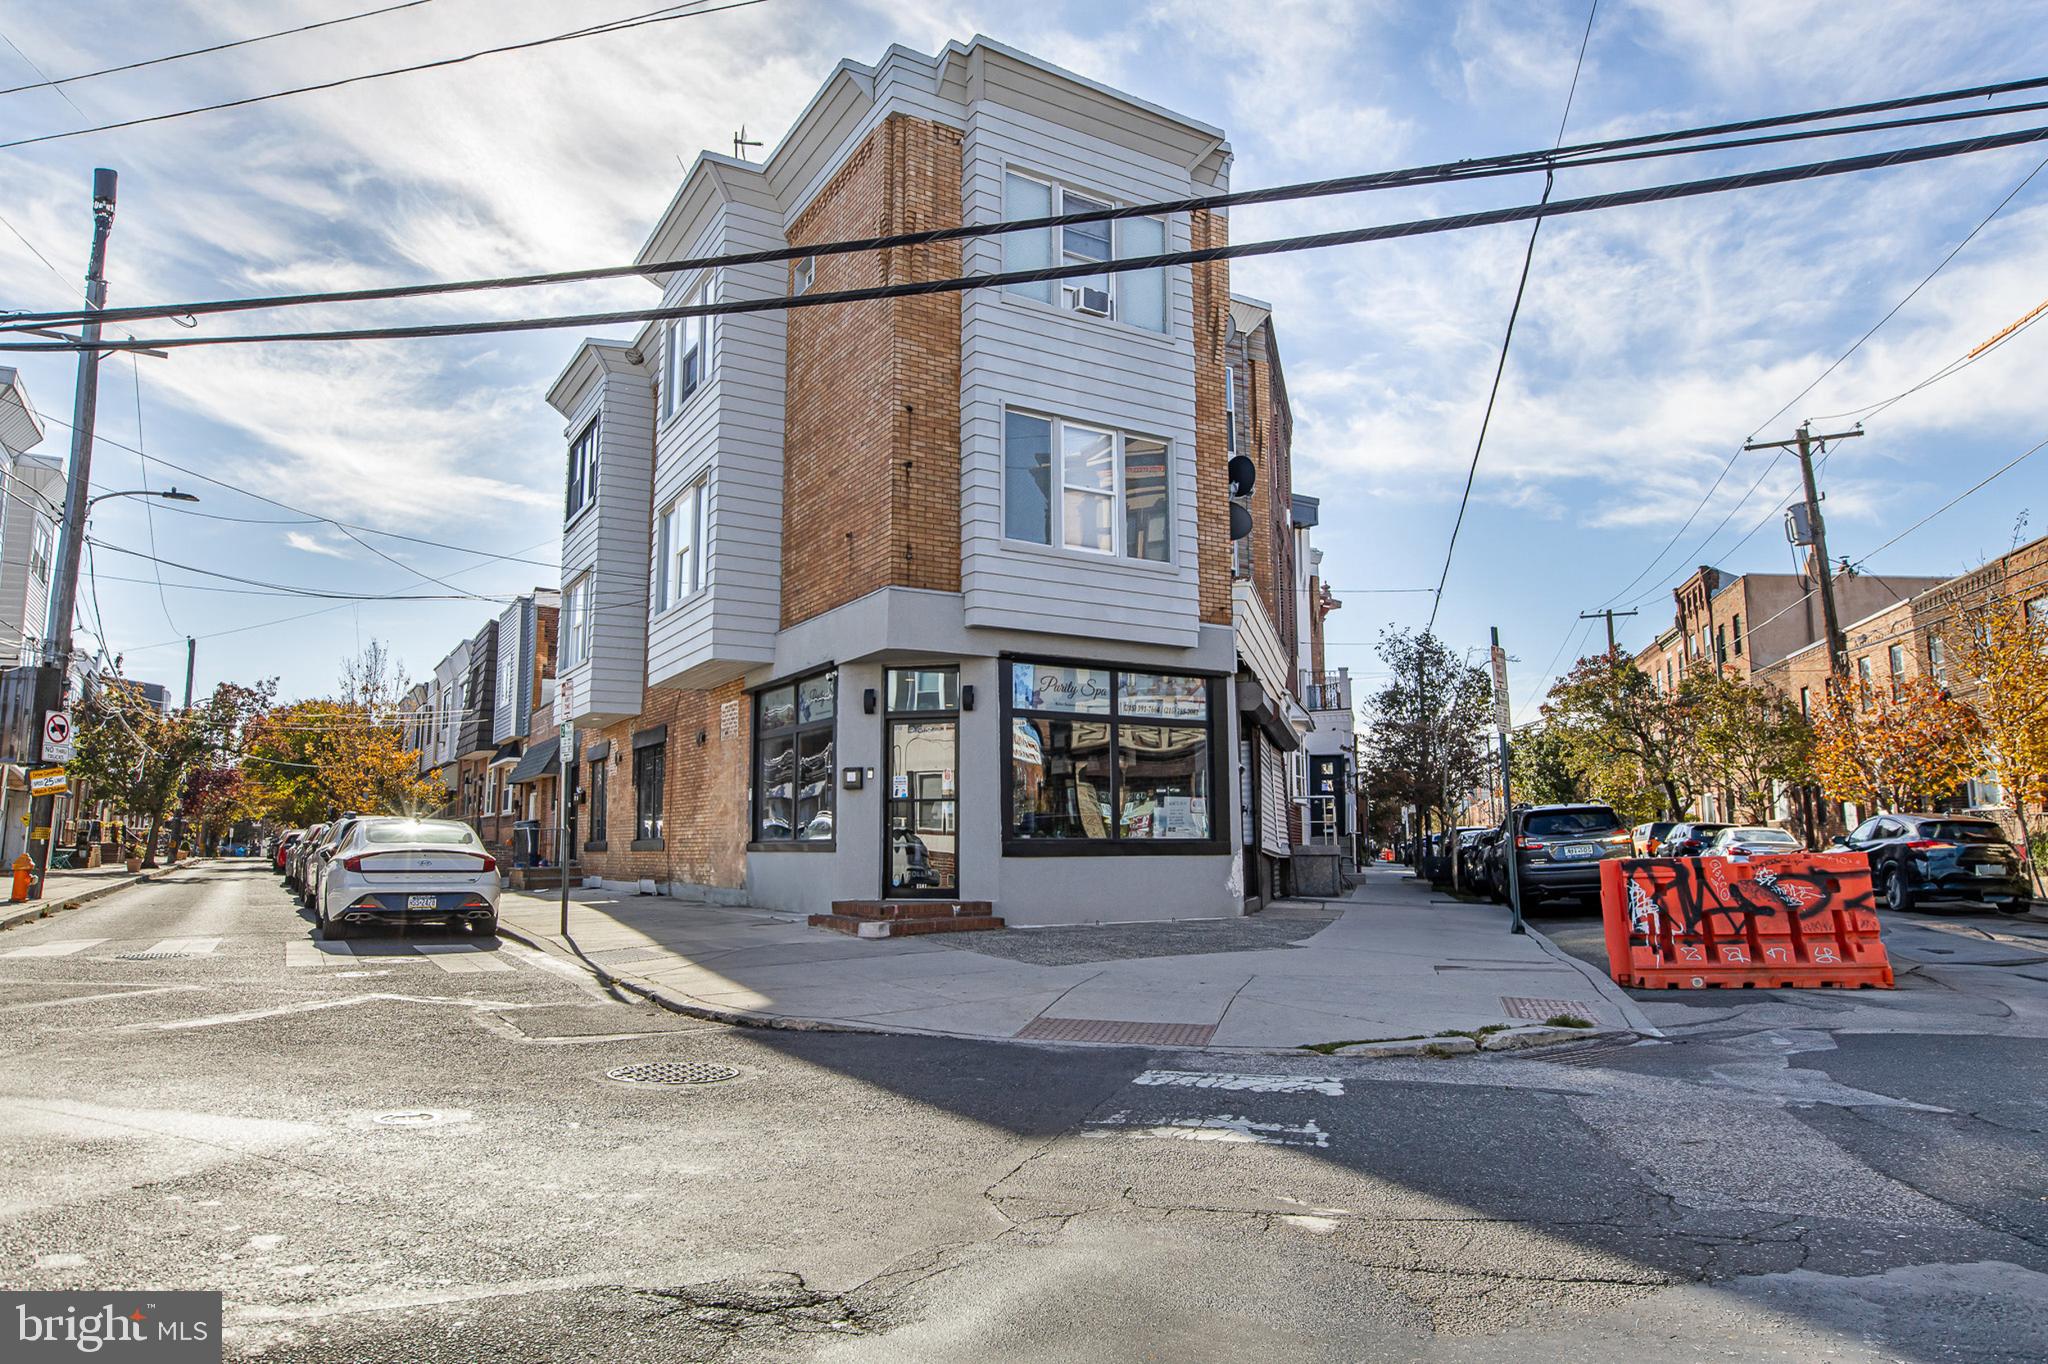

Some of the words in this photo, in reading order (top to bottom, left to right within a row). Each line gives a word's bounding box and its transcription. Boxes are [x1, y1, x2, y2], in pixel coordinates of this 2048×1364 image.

[1039, 675, 1078, 699] Purity
[1081, 678, 1107, 700] Spa
[43, 777, 55, 787] 25
